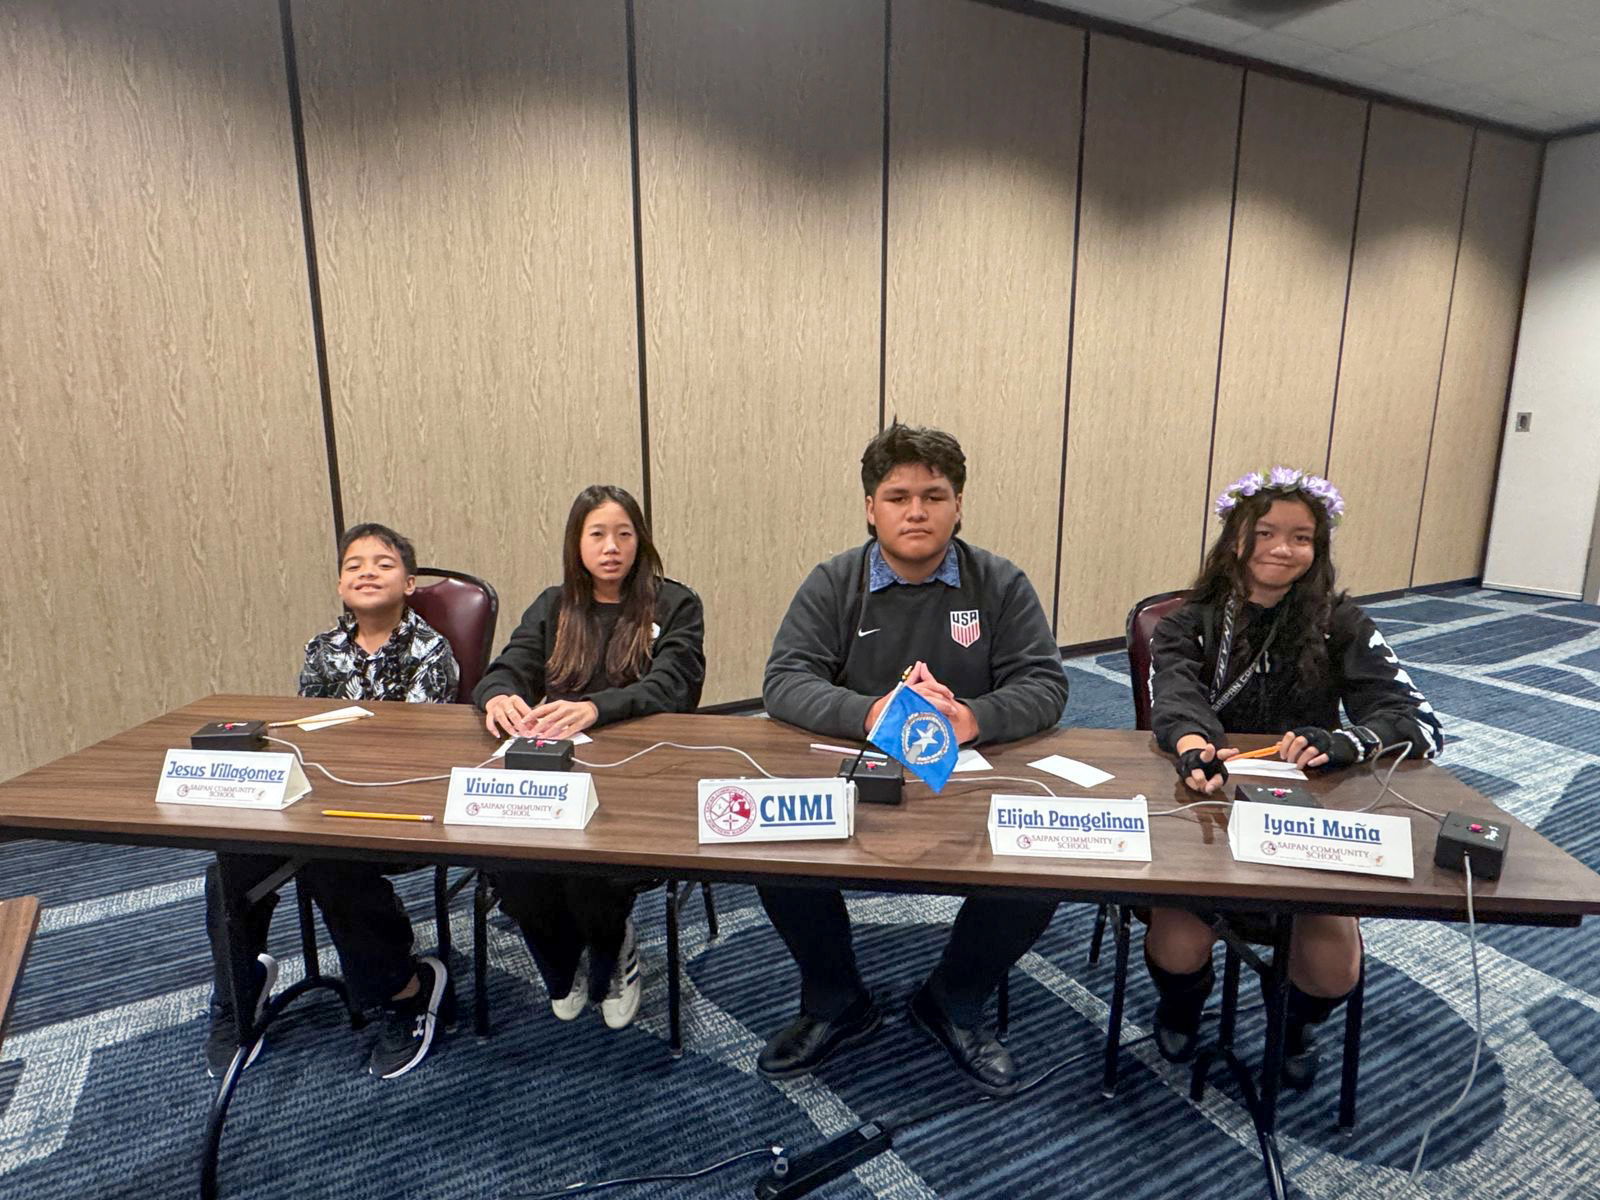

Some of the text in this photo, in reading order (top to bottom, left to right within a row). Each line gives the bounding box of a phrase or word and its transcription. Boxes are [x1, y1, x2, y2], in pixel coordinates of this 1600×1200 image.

[952, 611, 978, 626] USA
[167, 760, 286, 783] Jesus Villagomez
[214, 785, 256, 793] COMMUNITY
[466, 777, 569, 801] Vivian Chung
[502, 809, 531, 817] SCHOOL
[506, 803, 553, 812] COMMUNITY
[760, 794, 833, 823] CNMI
[997, 808, 1145, 832] Elijah Pangelinan
[1264, 813, 1381, 842] Iyani Muña
[1057, 842, 1090, 850] SCHOOL
[1061, 836, 1113, 845] COMMUNITY
[1277, 842, 1370, 858] SAIPAN COMMUNITY
[1306, 851, 1343, 862] SCHOOL
